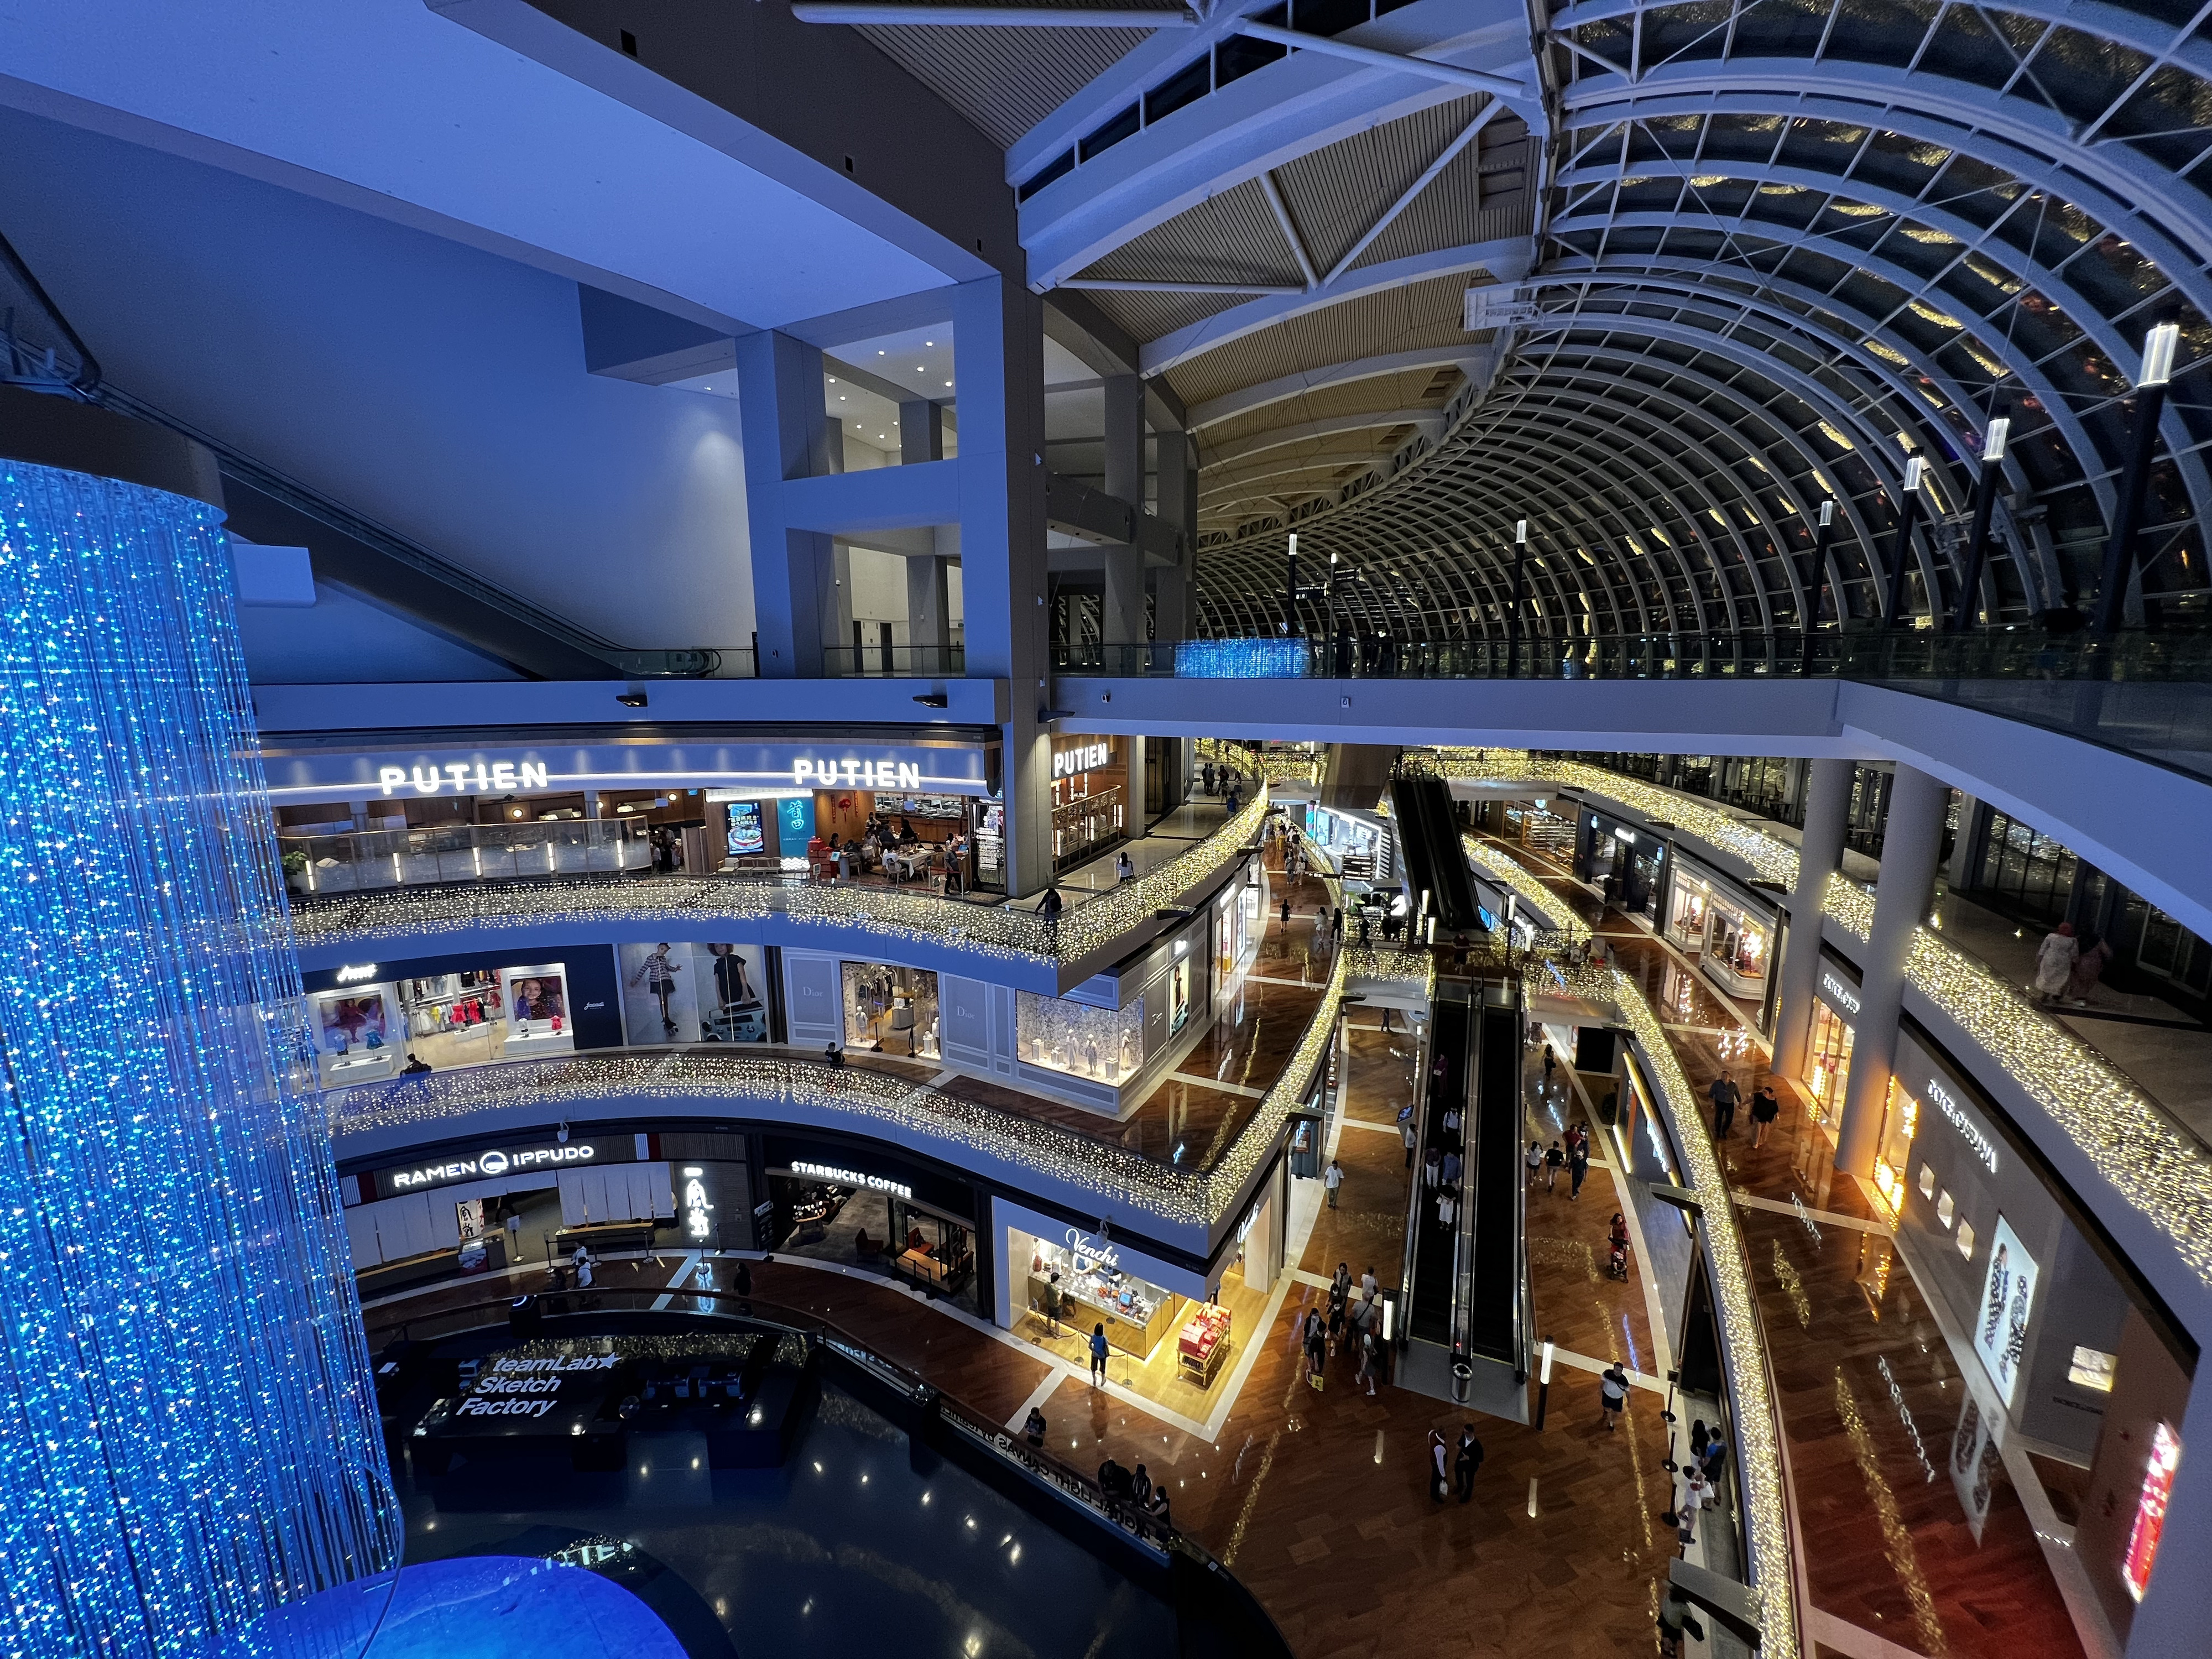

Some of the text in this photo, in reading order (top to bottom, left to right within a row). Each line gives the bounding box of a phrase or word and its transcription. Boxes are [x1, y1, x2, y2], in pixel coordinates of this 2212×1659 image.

[793, 759, 920, 789] PUTIEN
[1053, 742, 1108, 778] PUTIEN
[380, 762, 548, 795] PUTIEN
[802, 987, 823, 998] Dior
[956, 1005, 975, 1021] Dior
[393, 1145, 594, 1188] RAMEN IPPUDO
[791, 1160, 912, 1199] STARBUCKS COFFEE
[1066, 1228, 1119, 1267] Venchi
[493, 1354, 598, 1373] teamLab
[474, 1375, 562, 1394] Sketch
[455, 1397, 558, 1418] Factory
